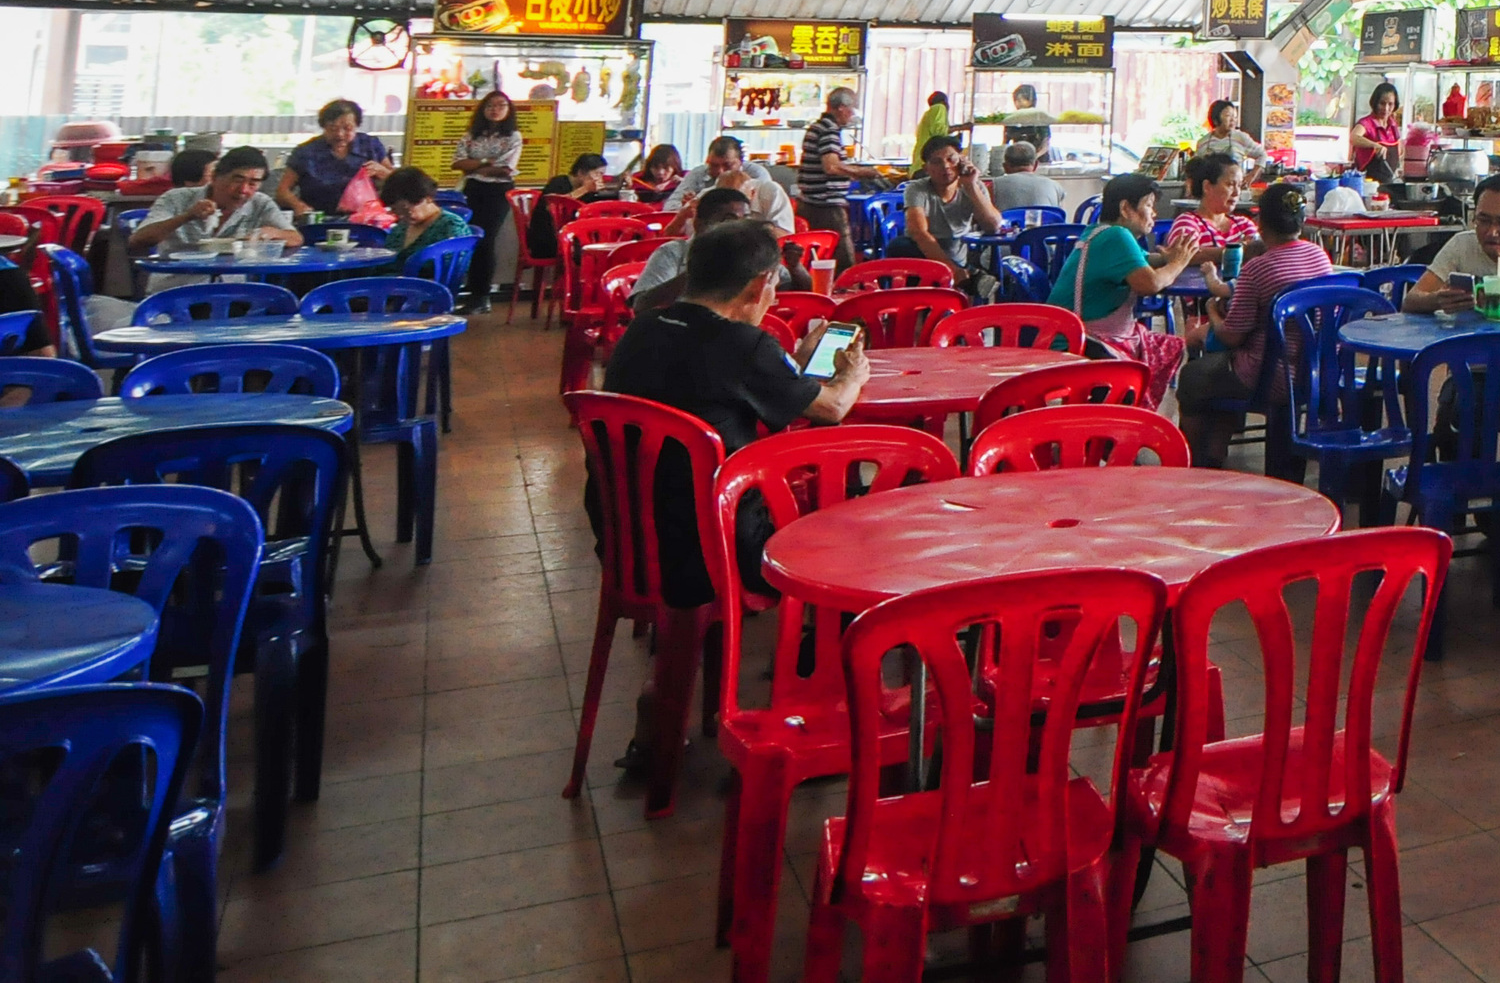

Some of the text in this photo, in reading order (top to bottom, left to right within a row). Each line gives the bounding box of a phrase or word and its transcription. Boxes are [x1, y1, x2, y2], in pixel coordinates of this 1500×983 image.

[791, 24, 861, 55] 雲吞麵
[985, 43, 1008, 60] 100
[1045, 42, 1105, 57] 淋面
